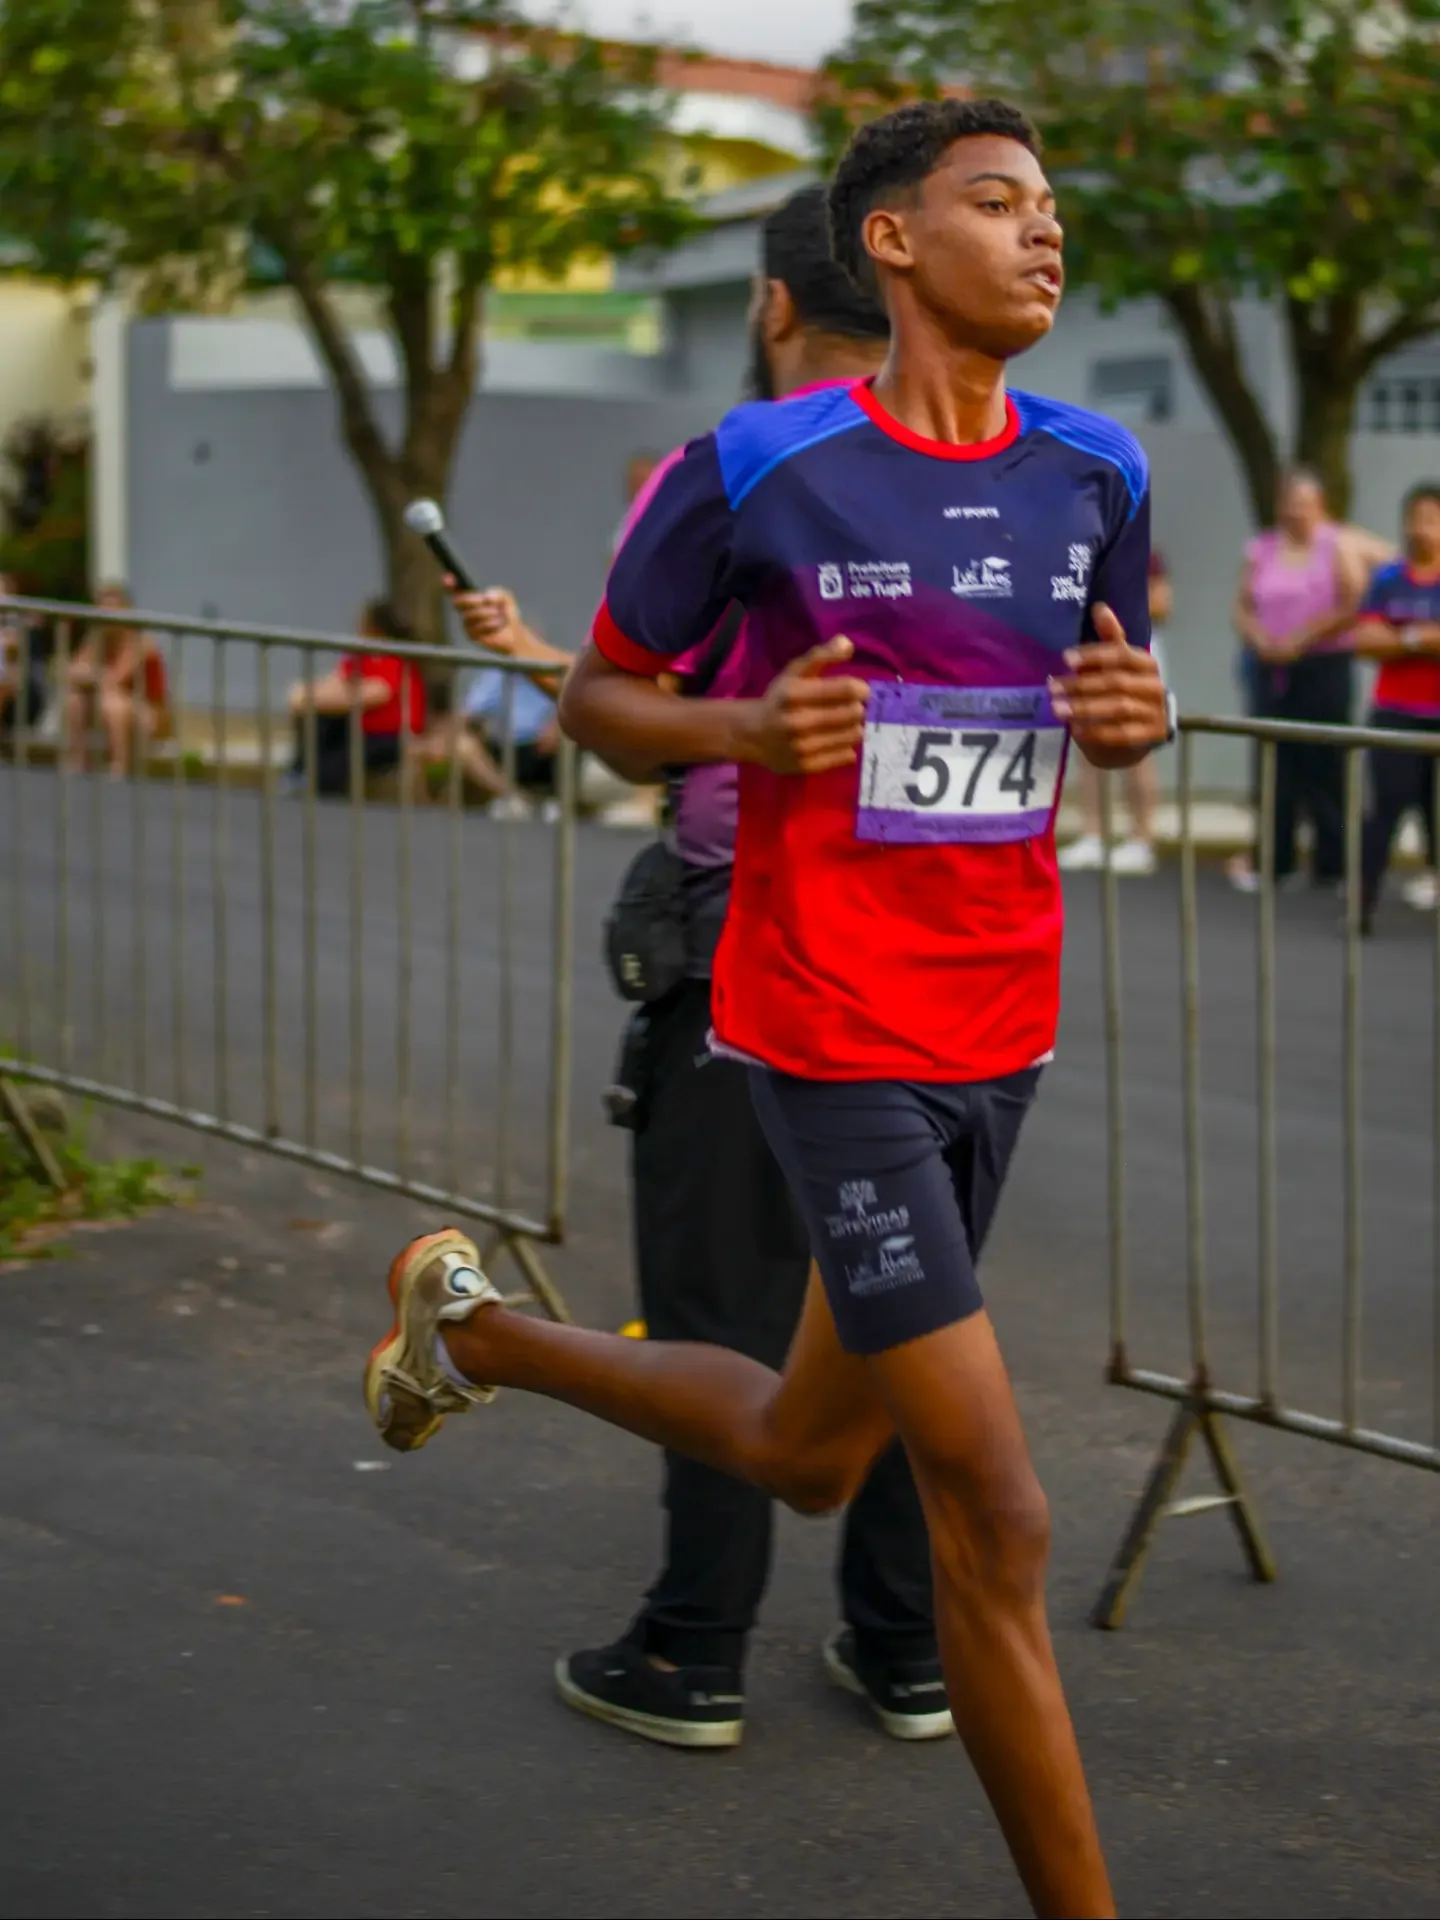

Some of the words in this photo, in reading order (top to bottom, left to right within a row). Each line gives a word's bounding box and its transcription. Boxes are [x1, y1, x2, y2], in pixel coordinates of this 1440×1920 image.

[847, 561, 911, 576] Prefeitura
[850, 580, 872, 598] de
[904, 731, 1036, 807] 574
